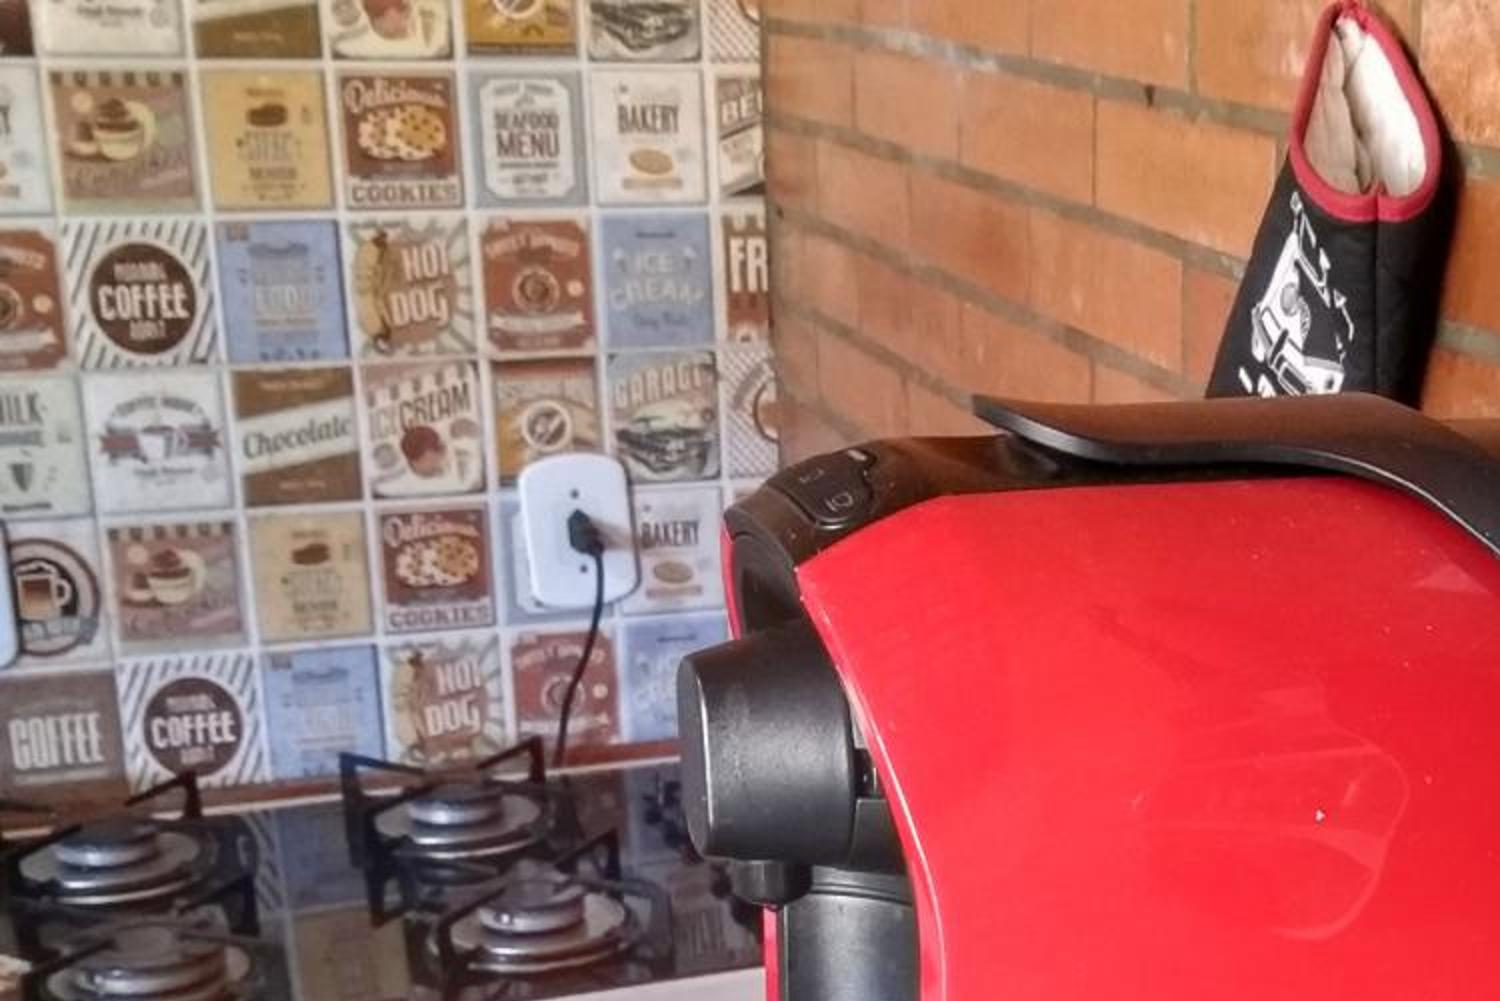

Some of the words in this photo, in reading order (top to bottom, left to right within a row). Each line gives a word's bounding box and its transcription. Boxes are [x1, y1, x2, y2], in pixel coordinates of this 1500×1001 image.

[617, 104, 680, 135] BAKERY
[495, 131, 560, 158] MENU
[401, 240, 449, 281] HOT
[97, 281, 190, 321] COFFEE
[389, 281, 449, 328] DOG
[242, 415, 352, 460] Chocolate
[150, 711, 237, 749] COFFEE
[424, 697, 481, 737] DOG
[8, 710, 104, 770] COFFEE
